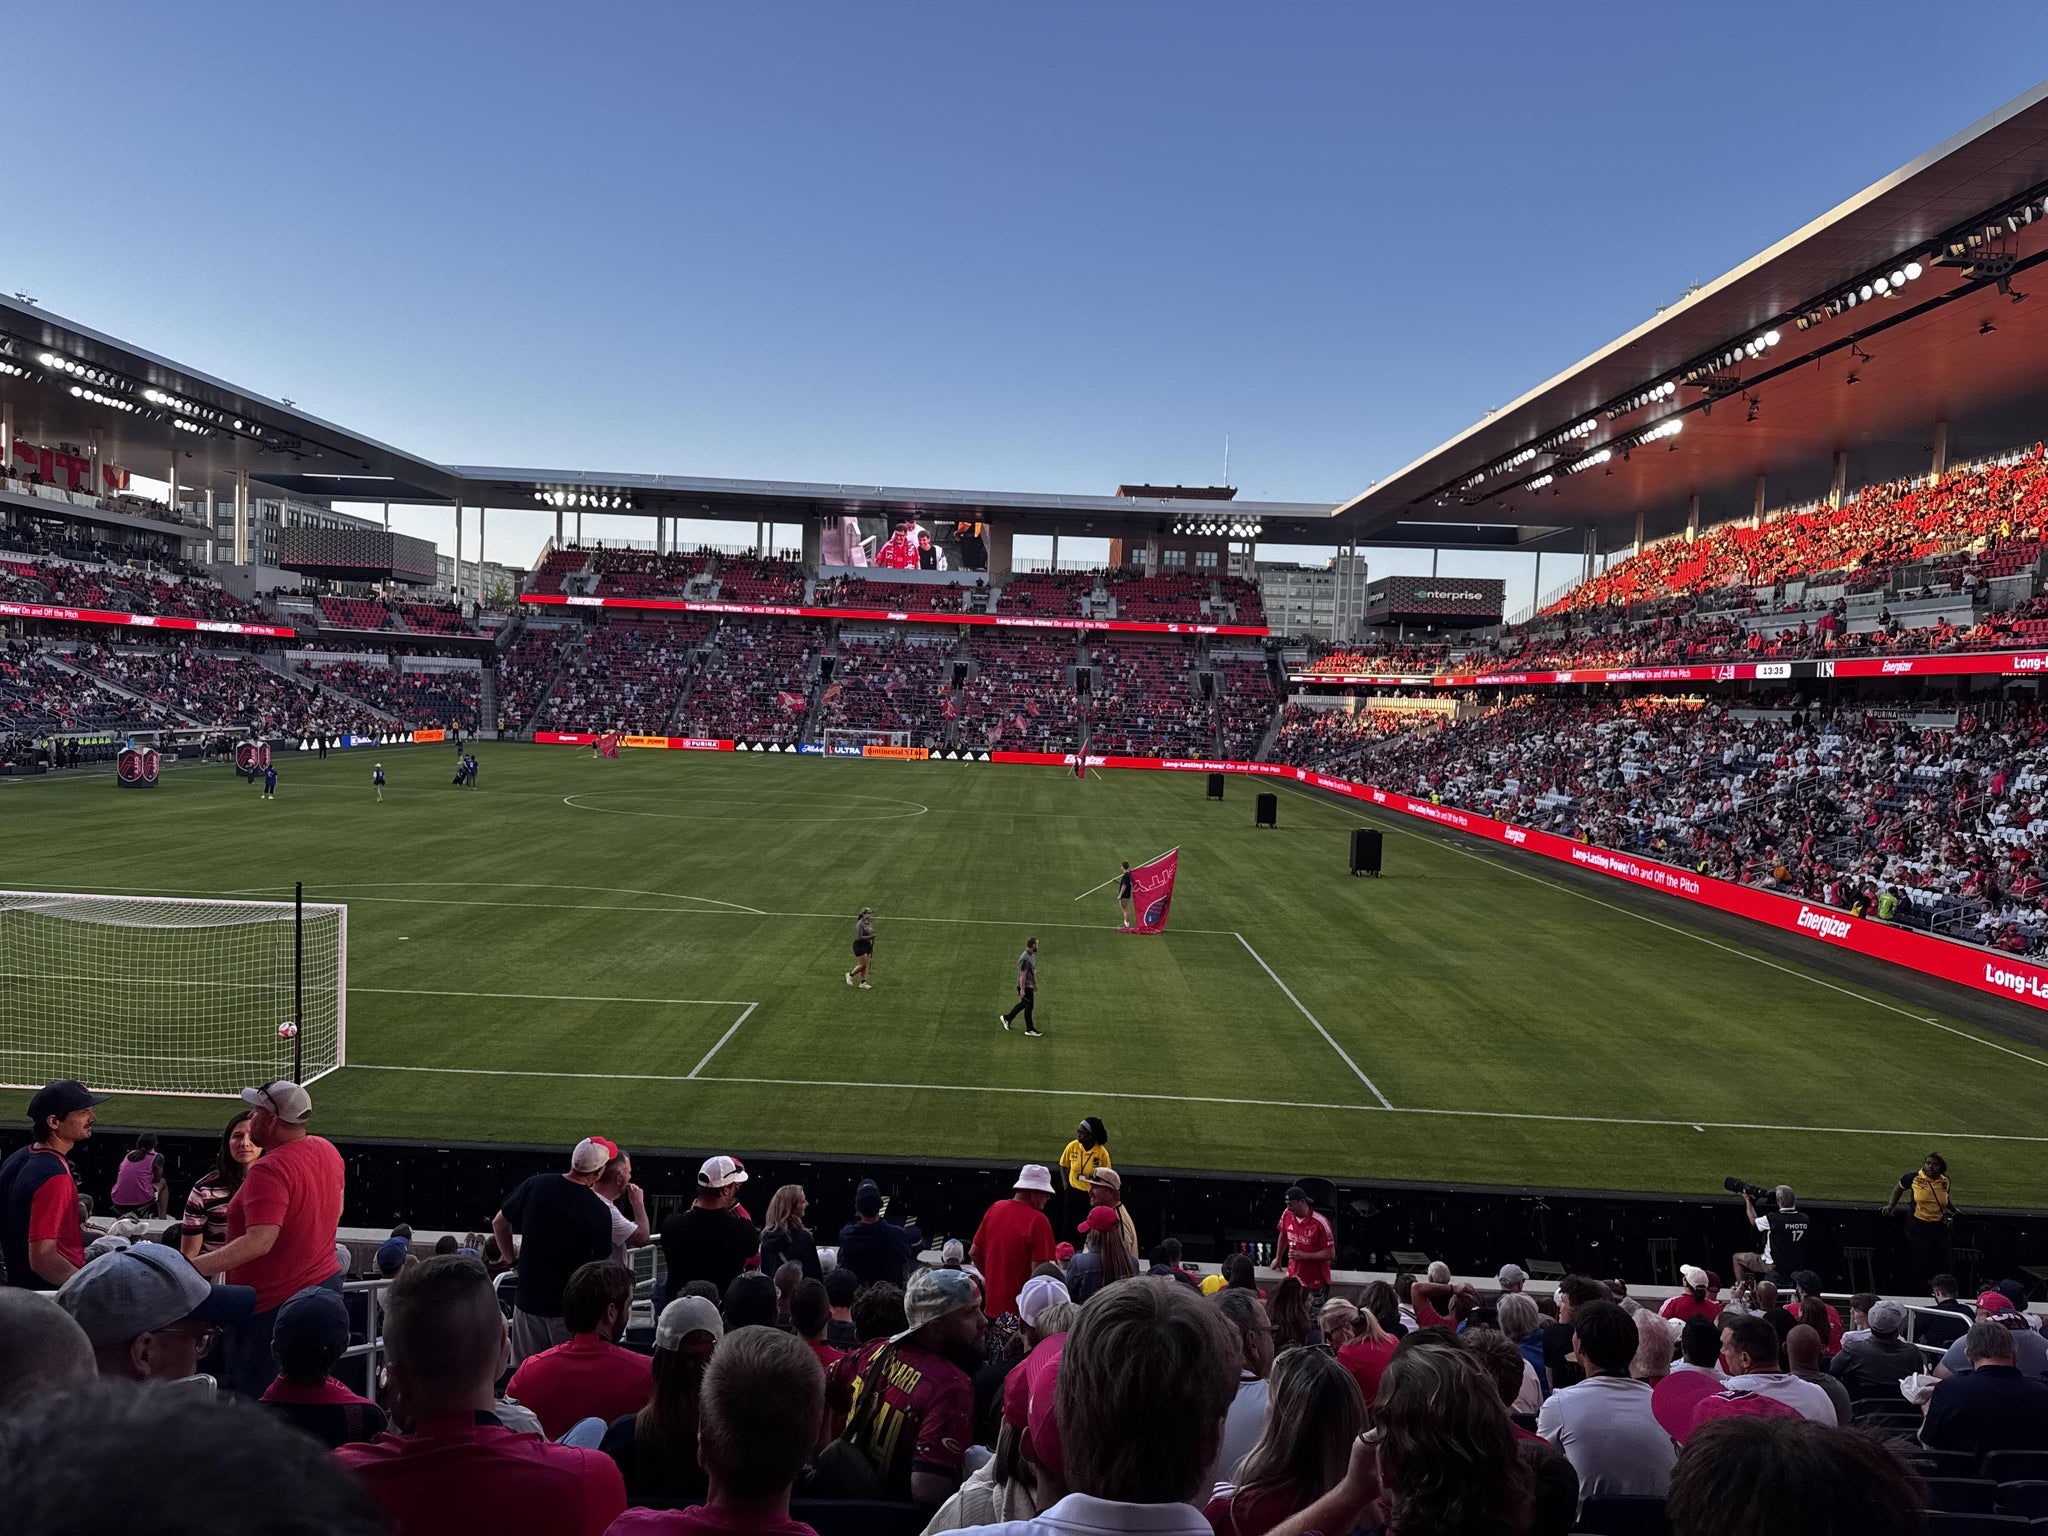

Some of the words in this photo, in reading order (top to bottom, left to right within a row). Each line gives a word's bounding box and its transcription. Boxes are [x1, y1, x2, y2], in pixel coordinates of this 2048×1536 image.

[1417, 590, 1482, 601] enterprise
[32, 607, 42, 616] and
[65, 610, 79, 619] Pitch
[1763, 666, 1784, 676] 13:35
[1882, 660, 1913, 674] Energizer
[835, 746, 860, 754] ULTRA
[1064, 754, 1106, 766] Enizer
[1572, 847, 1609, 869] Long-Lasting
[1630, 864, 1639, 877] On
[1640, 868, 1653, 881] and
[1654, 870, 1664, 885] Off
[1666, 874, 1678, 889] the
[1680, 877, 1699, 895] Pitch
[1797, 906, 1852, 939] Energizer
[1791, 1230, 1804, 1241] 17
